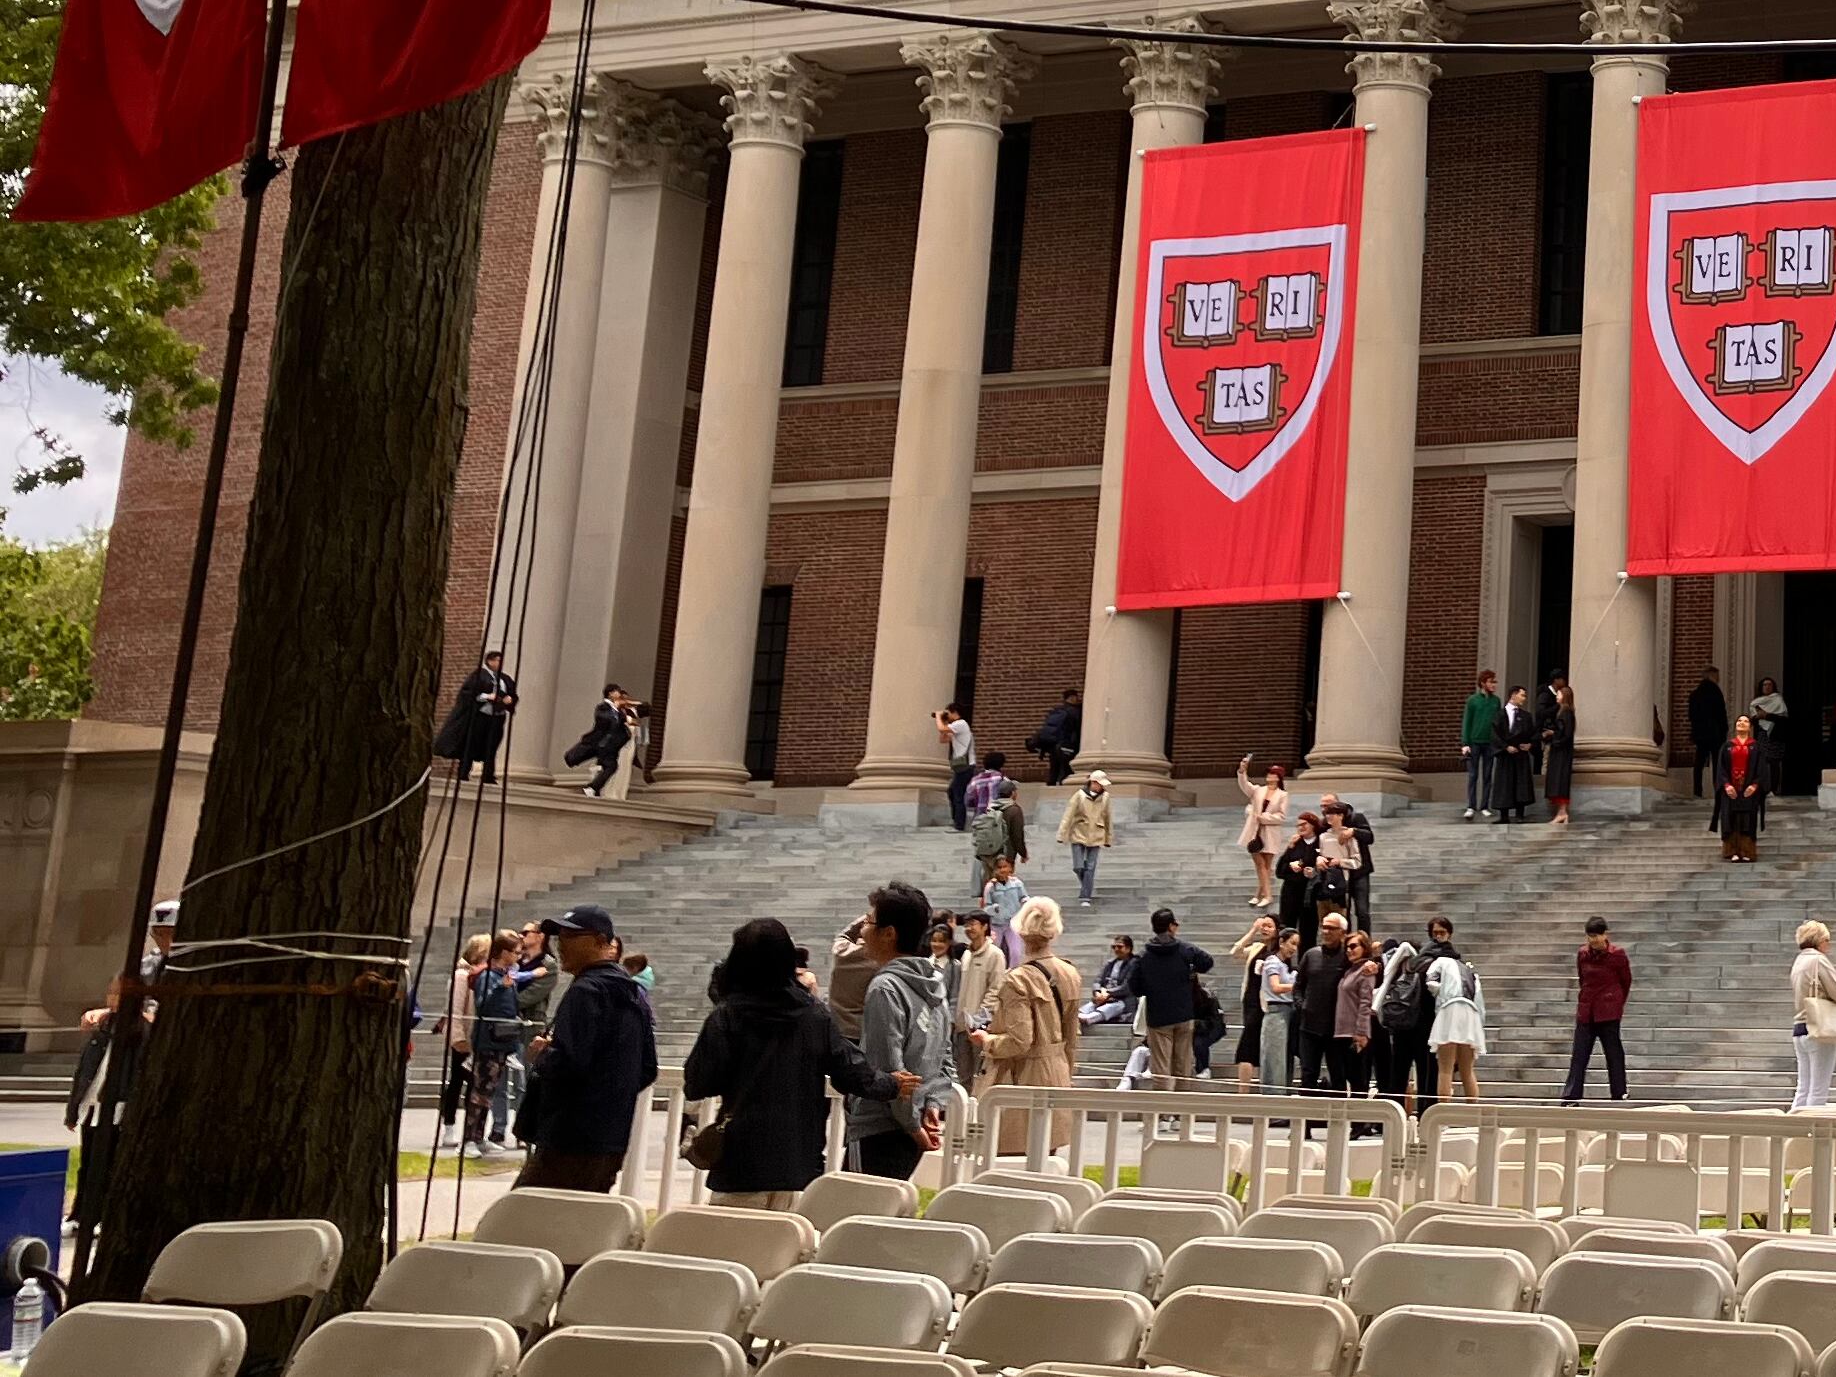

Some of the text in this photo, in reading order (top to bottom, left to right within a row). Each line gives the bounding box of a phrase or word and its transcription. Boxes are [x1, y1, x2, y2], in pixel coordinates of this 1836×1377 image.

[1694, 244, 1813, 279] VE RI
[1187, 290, 1300, 323] VE RI
[1730, 337, 1778, 367] TAS
[1220, 380, 1265, 408] TAS
